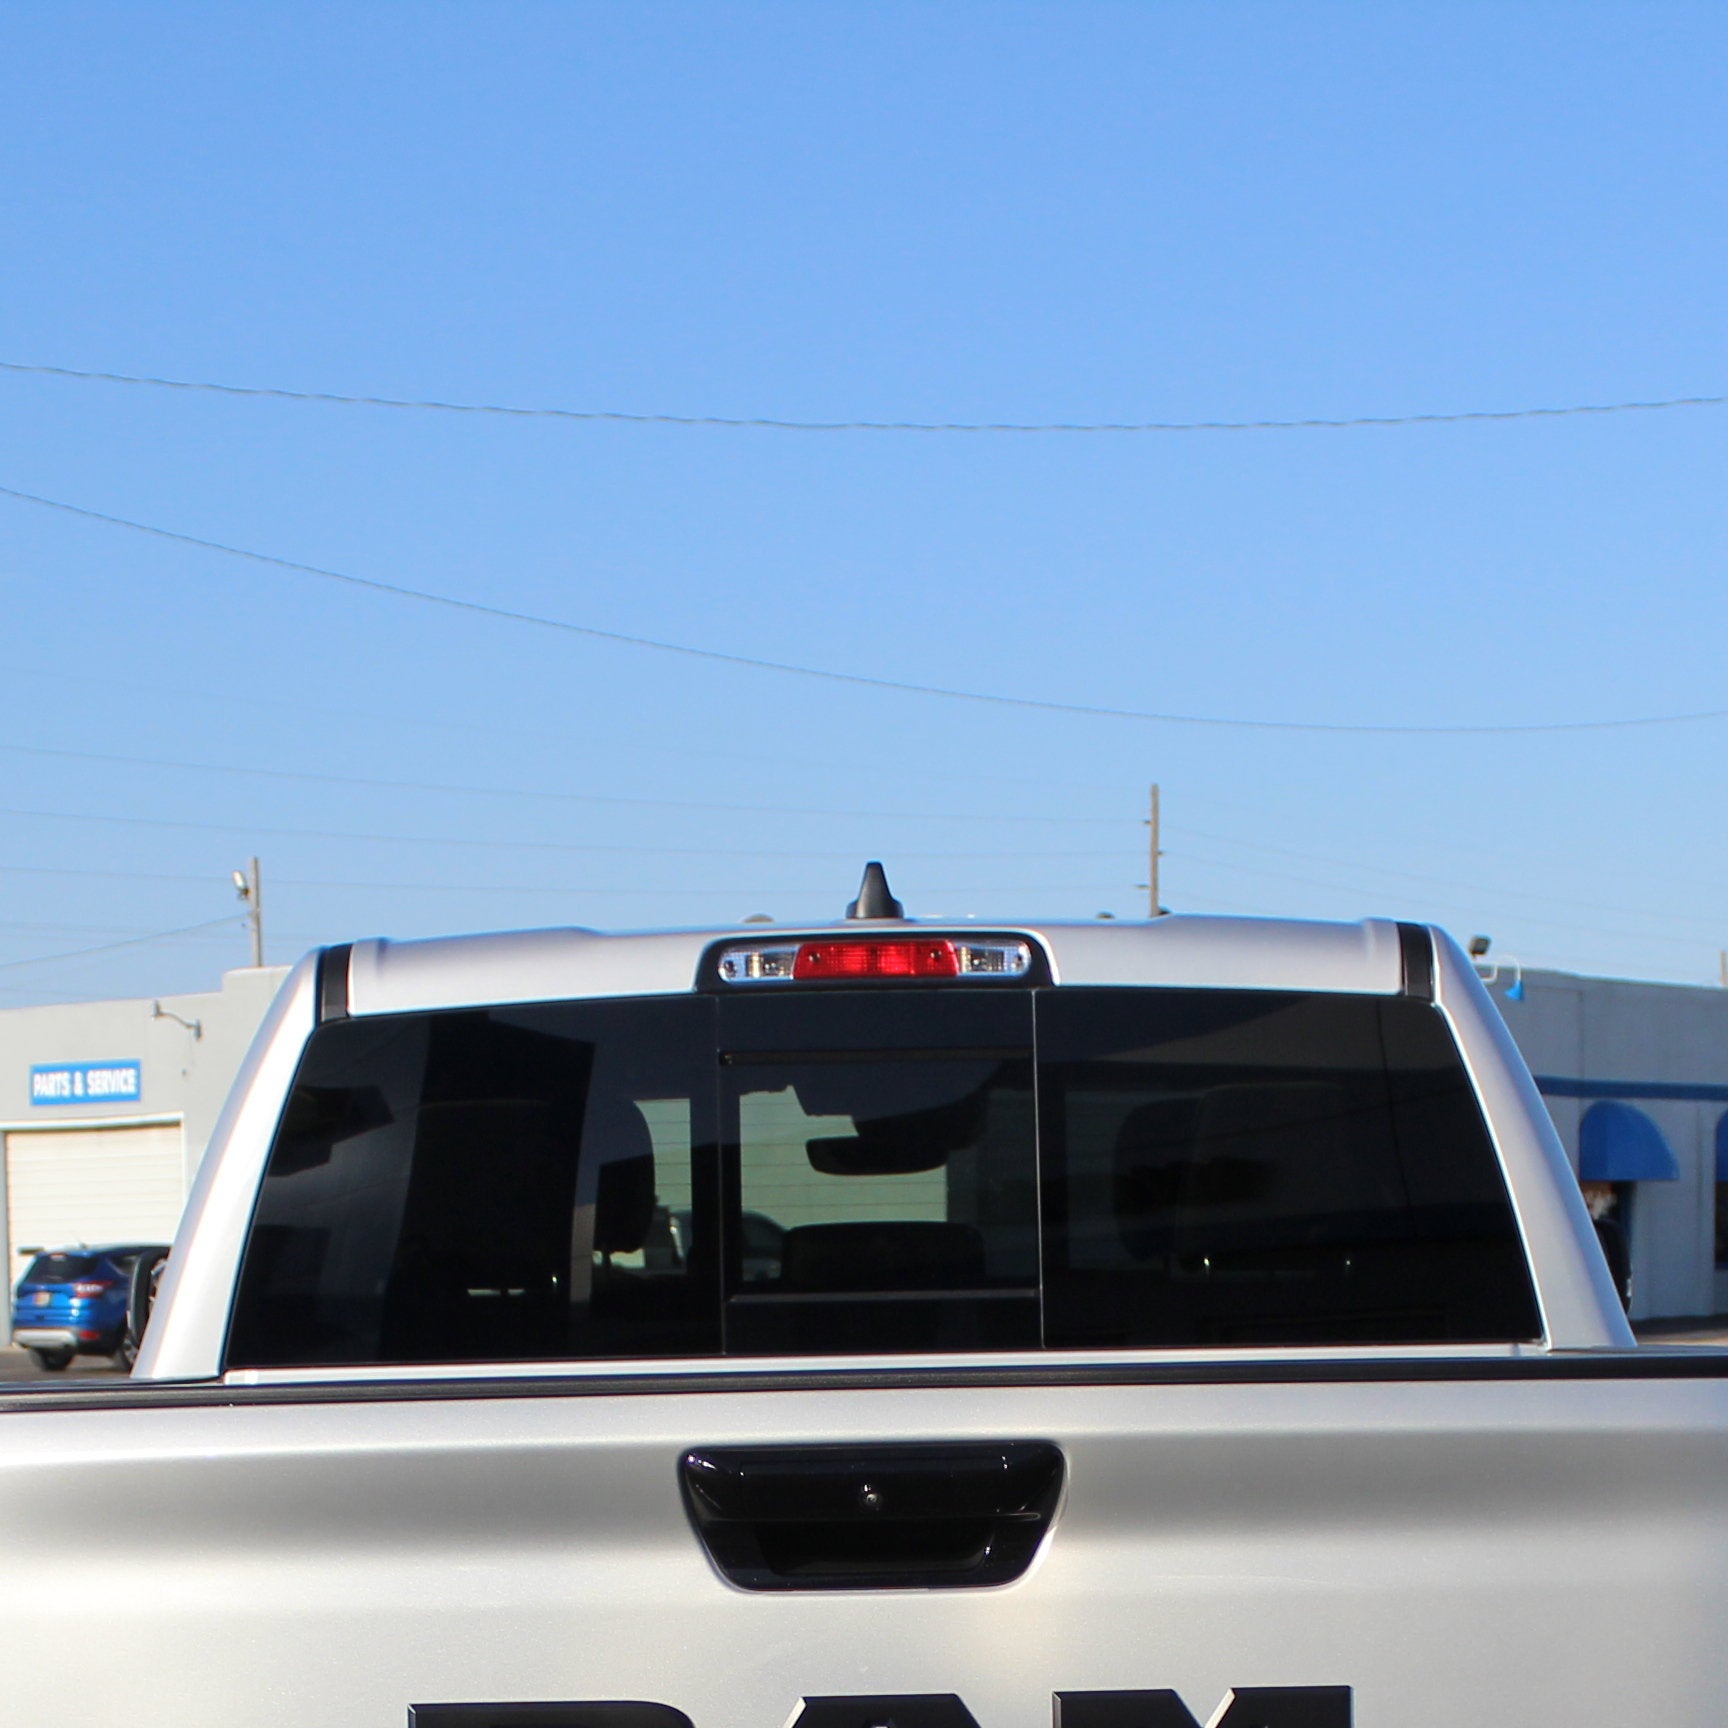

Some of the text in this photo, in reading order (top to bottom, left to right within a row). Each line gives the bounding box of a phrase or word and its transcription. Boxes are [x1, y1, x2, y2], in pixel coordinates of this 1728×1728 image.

[33, 1067, 137, 1098] PARTS & SERVICE
